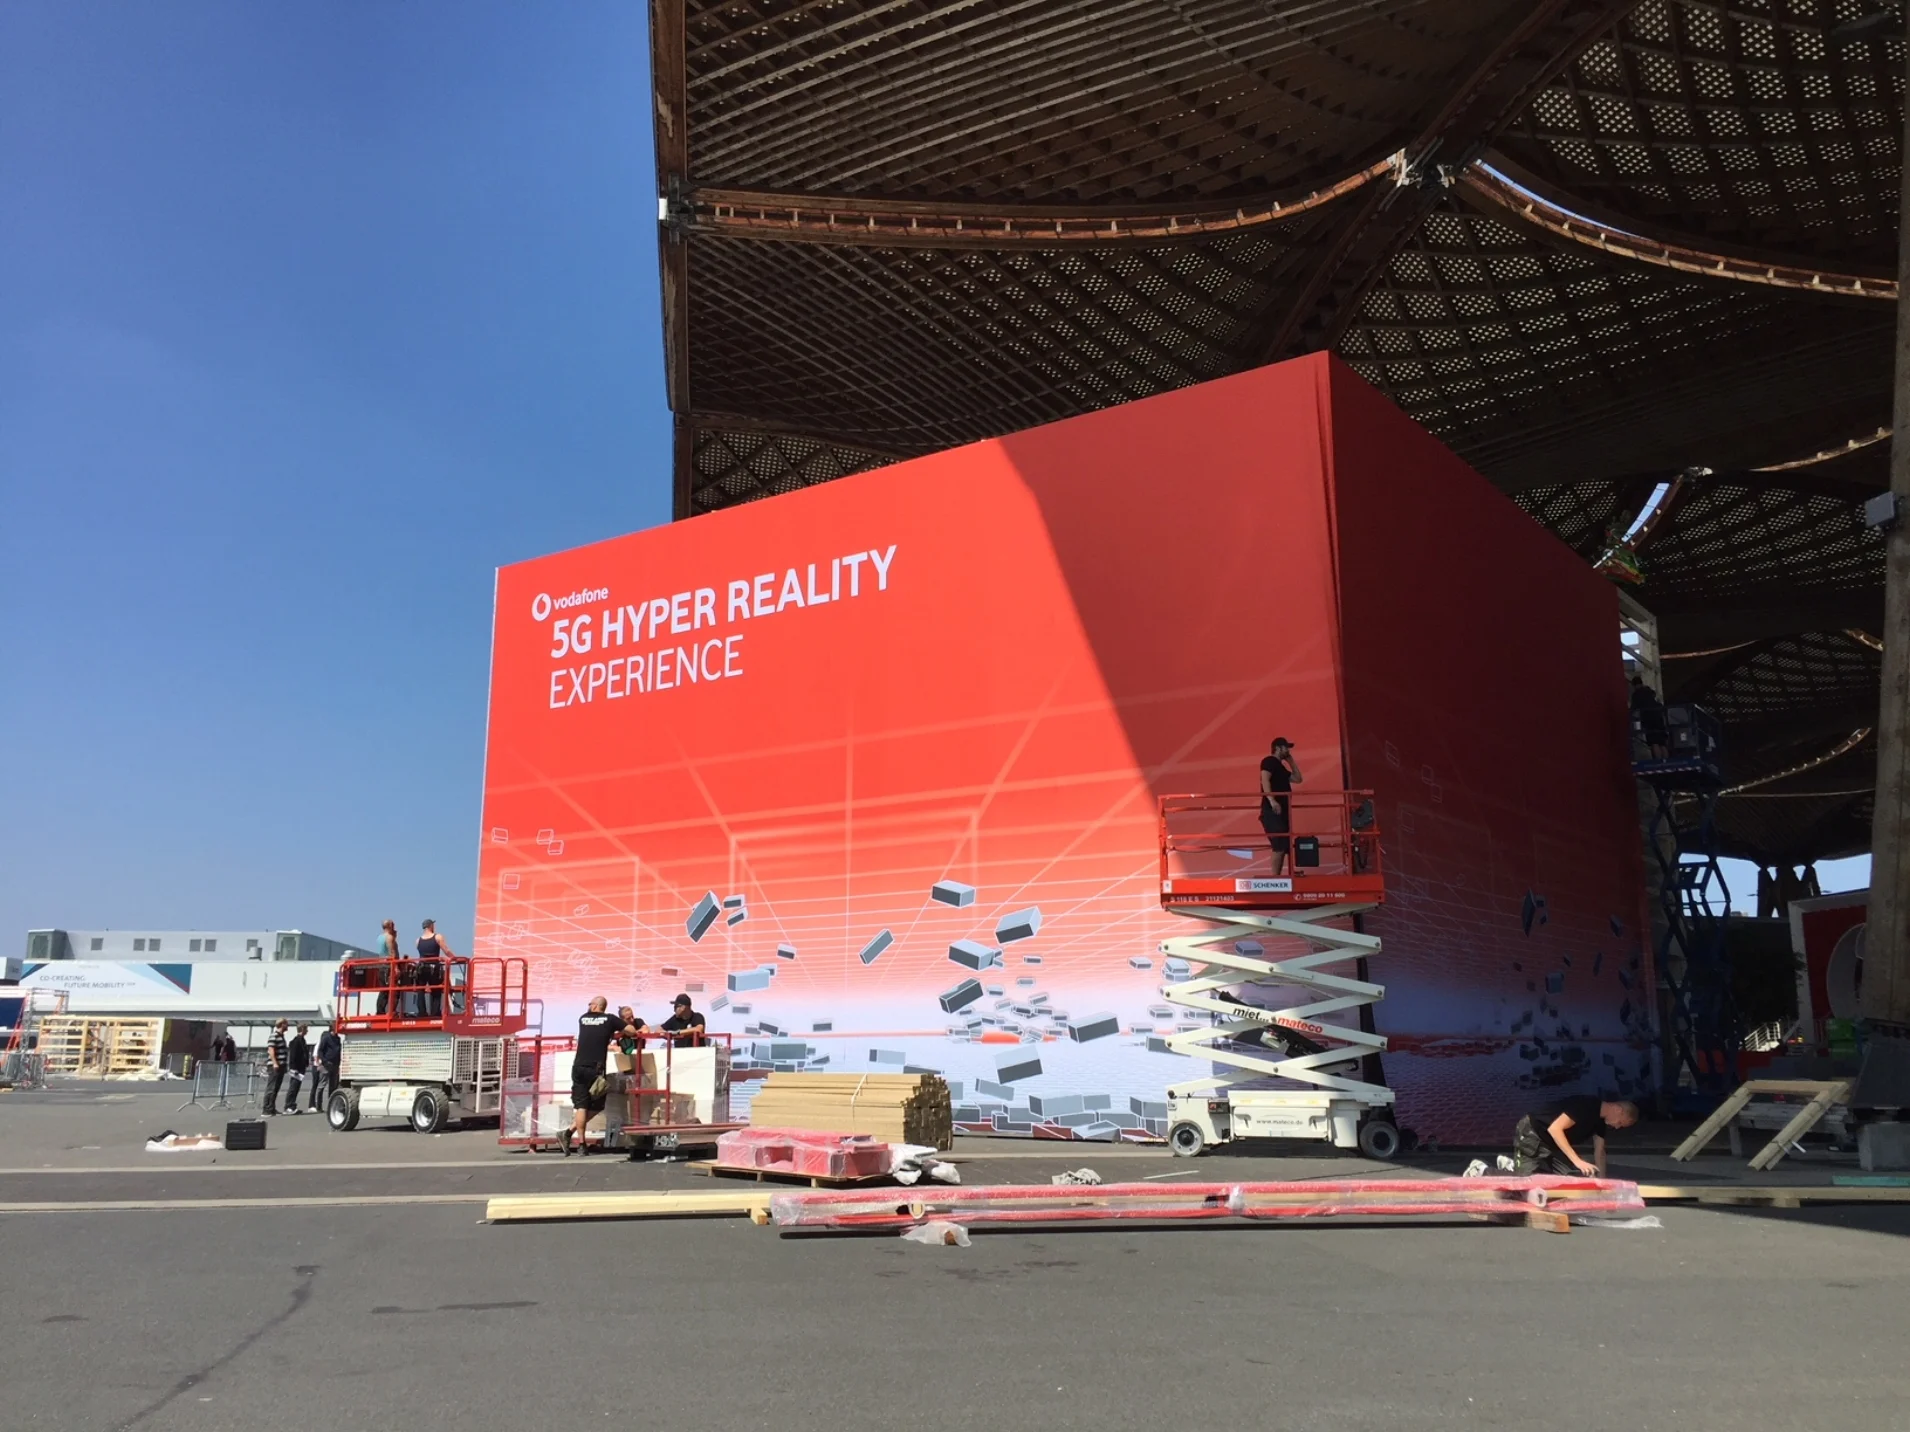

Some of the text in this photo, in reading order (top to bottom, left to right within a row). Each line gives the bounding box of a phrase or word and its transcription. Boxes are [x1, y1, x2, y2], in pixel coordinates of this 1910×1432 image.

[551, 545, 897, 658] 5G HYPER REALITY
[553, 587, 608, 610] vodafone
[549, 634, 743, 709] EXPERIENCE
[472, 1016, 501, 1024] mateco
[1277, 1016, 1323, 1034] mateco
